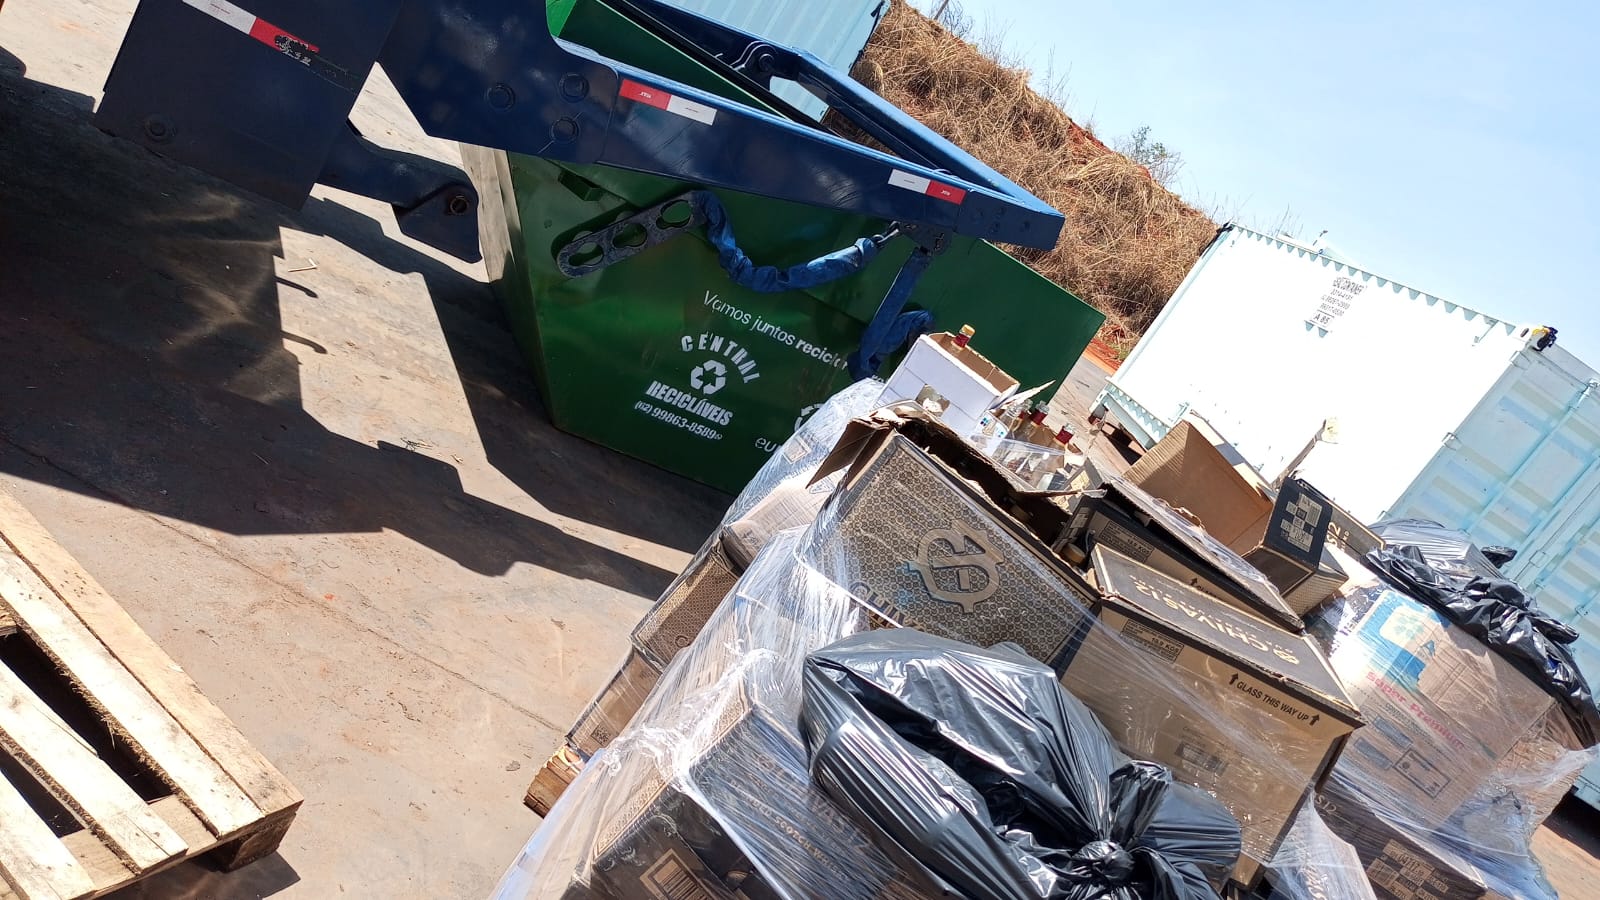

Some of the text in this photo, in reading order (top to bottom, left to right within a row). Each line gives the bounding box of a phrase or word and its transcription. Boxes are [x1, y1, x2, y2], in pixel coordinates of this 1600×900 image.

[704, 290, 752, 325] Vamos
[751, 315, 796, 346] juntos
[681, 332, 760, 384] CENTRAL
[645, 380, 733, 426] RECICLÁVEIS
[1236, 681, 1309, 722] GLASS THIS WAY UP
[1367, 670, 1406, 703] Super
[771, 815, 813, 850] SCOTCH
